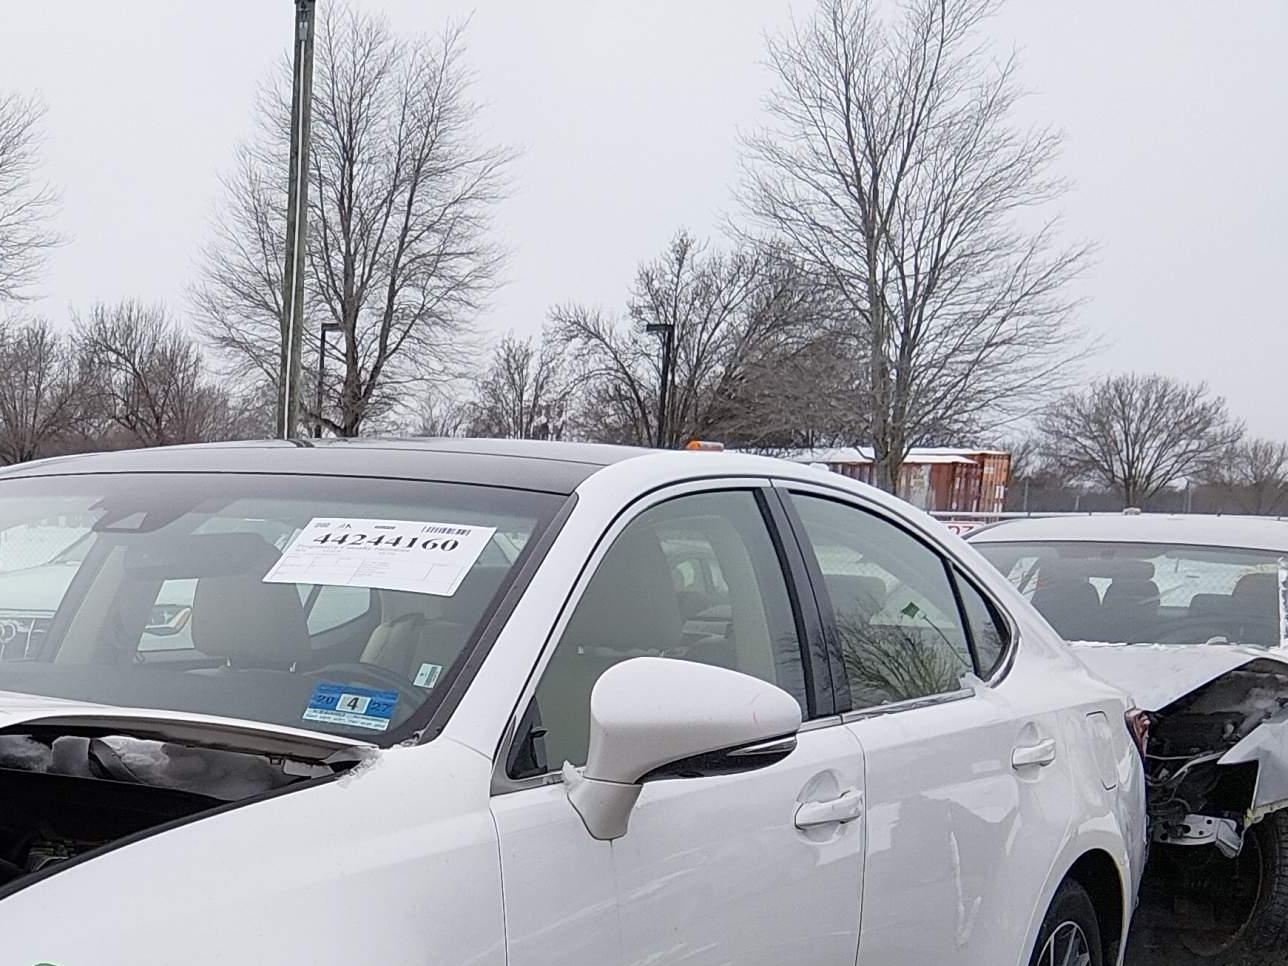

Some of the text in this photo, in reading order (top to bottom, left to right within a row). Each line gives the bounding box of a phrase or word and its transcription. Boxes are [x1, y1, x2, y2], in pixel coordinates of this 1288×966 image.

[313, 533, 460, 552] 44244160
[315, 694, 393, 713] 20 4 27
